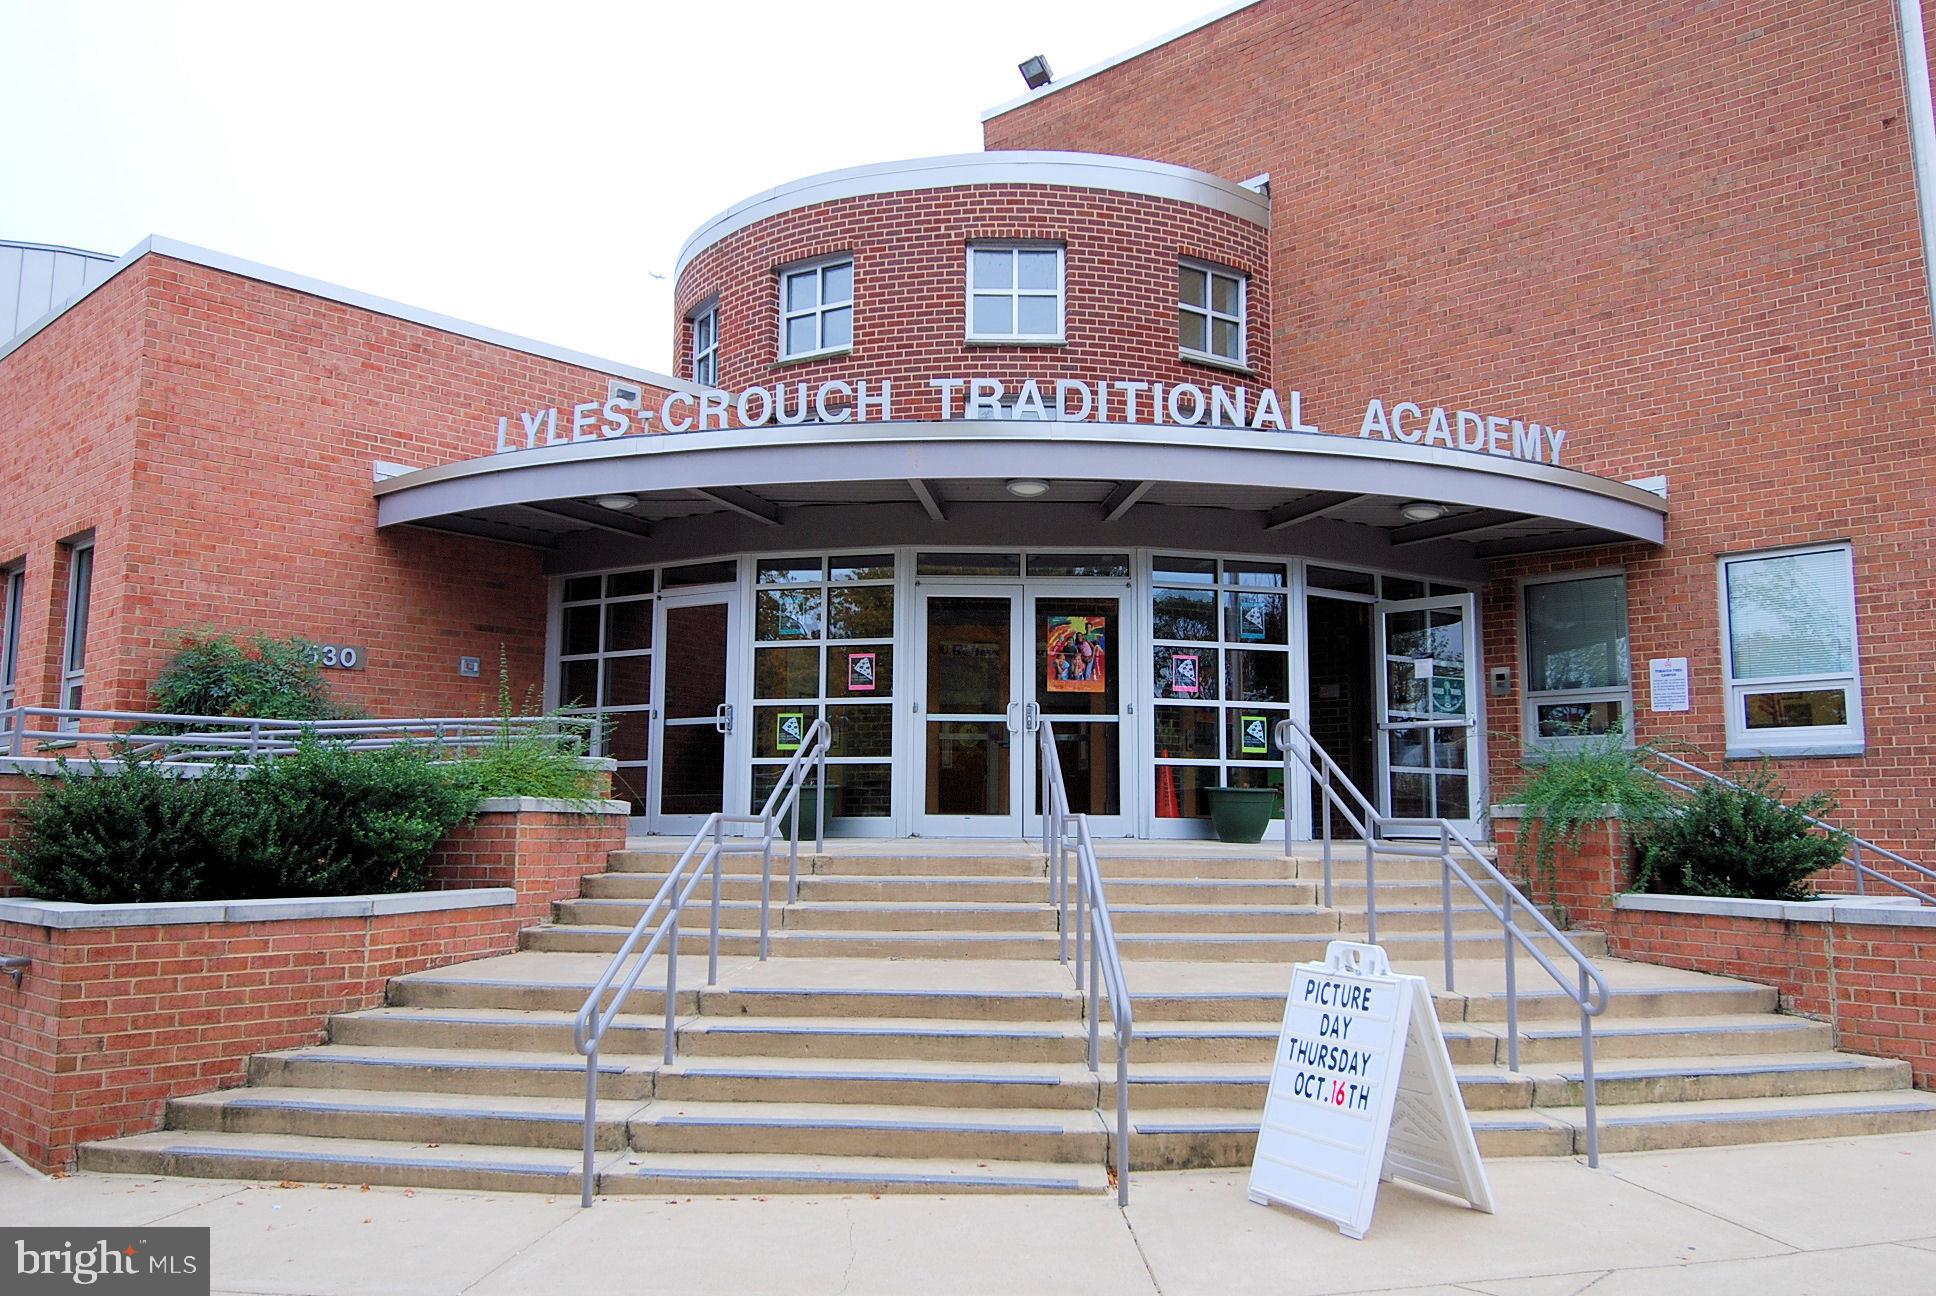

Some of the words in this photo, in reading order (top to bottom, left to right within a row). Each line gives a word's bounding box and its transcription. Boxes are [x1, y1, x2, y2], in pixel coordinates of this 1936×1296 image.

[496, 379, 892, 454] LYLES-CROUCH
[930, 378, 1319, 434] TRADITIONAL
[1359, 398, 1567, 466] ACADEMY
[1304, 979, 1372, 1012] PICTURE
[1319, 1013, 1352, 1040] DAY
[1289, 1037, 1371, 1077] THURSDAY
